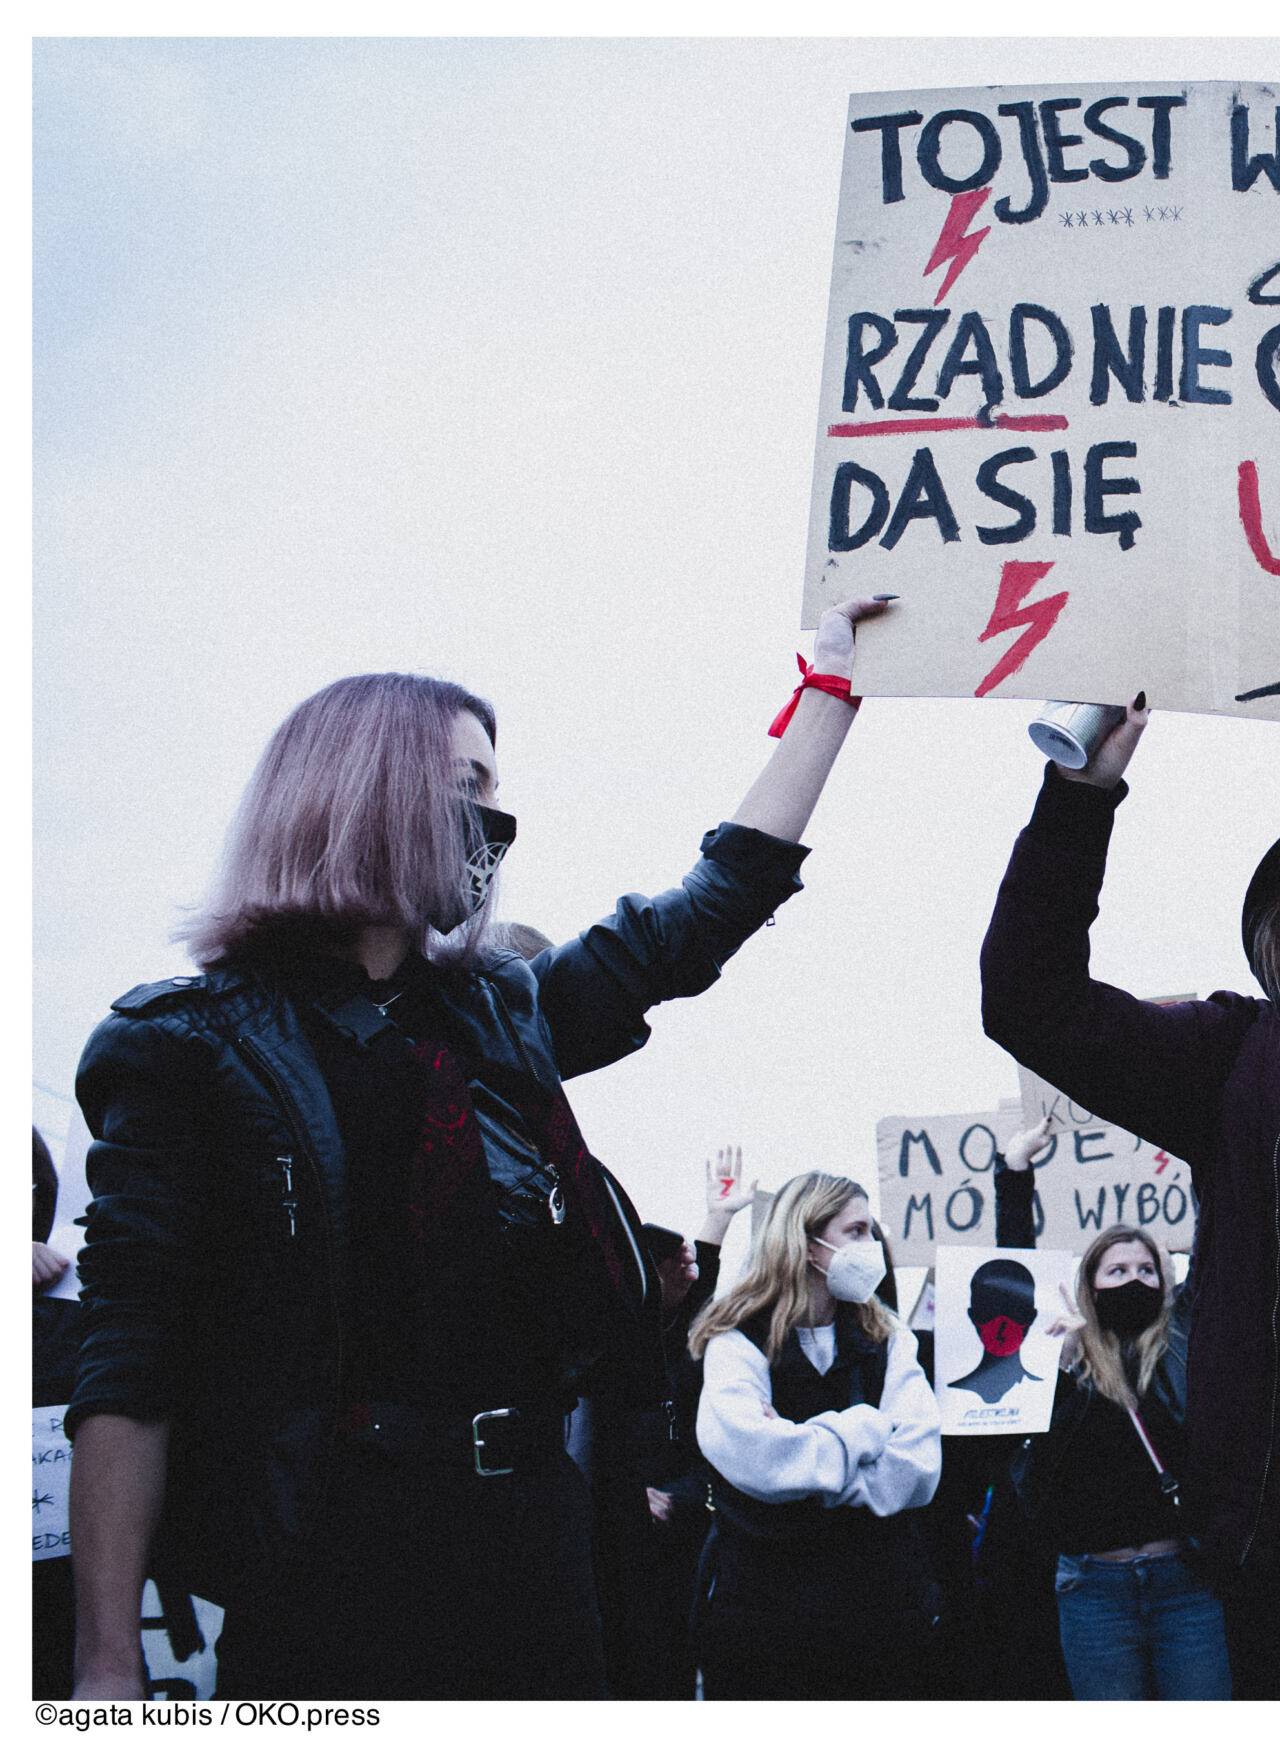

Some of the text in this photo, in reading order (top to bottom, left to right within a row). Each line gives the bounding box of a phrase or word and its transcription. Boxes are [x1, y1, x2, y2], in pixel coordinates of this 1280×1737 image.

[842, 303, 1075, 428] RZĄD
[1090, 303, 1232, 407] NIE
[976, 441, 1142, 551] SIĘ
